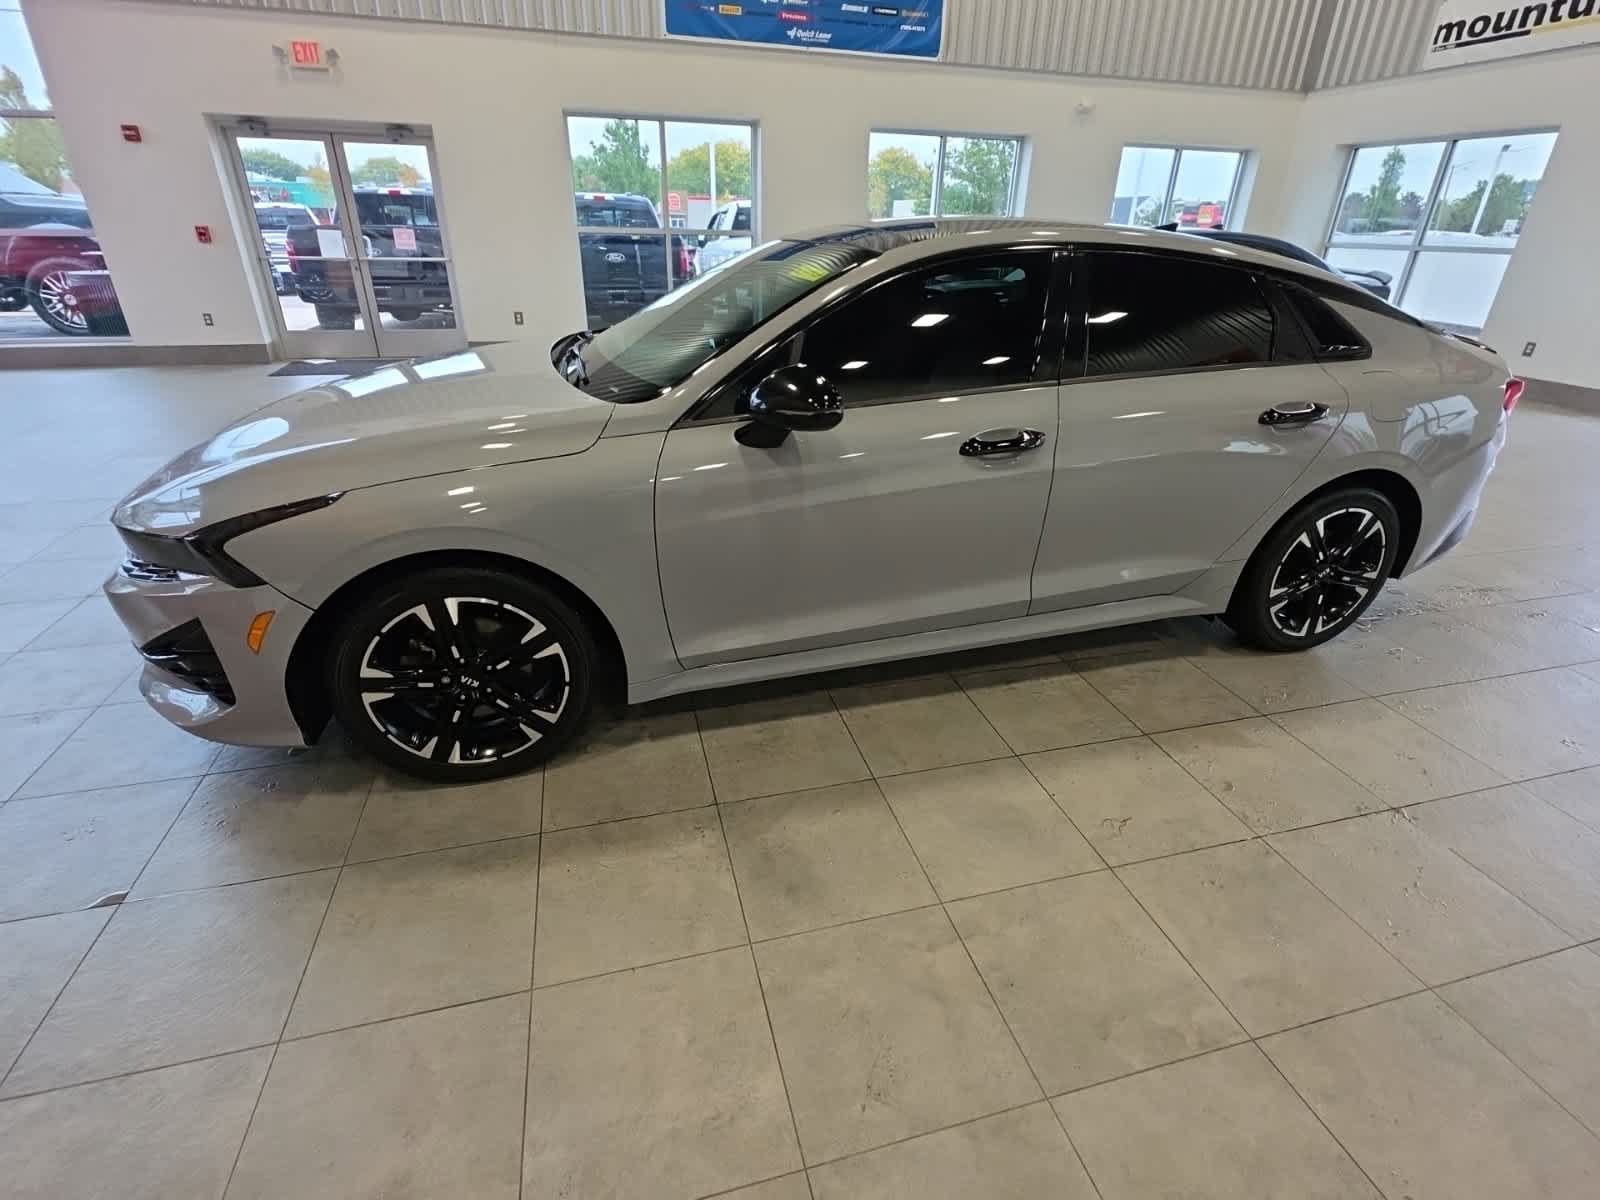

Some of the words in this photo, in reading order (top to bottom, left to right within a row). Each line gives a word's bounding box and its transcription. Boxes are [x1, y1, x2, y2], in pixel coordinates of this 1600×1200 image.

[1432, 0, 1600, 45] mountu
[292, 41, 320, 64] EXIT
[460, 675, 480, 688] KIA
